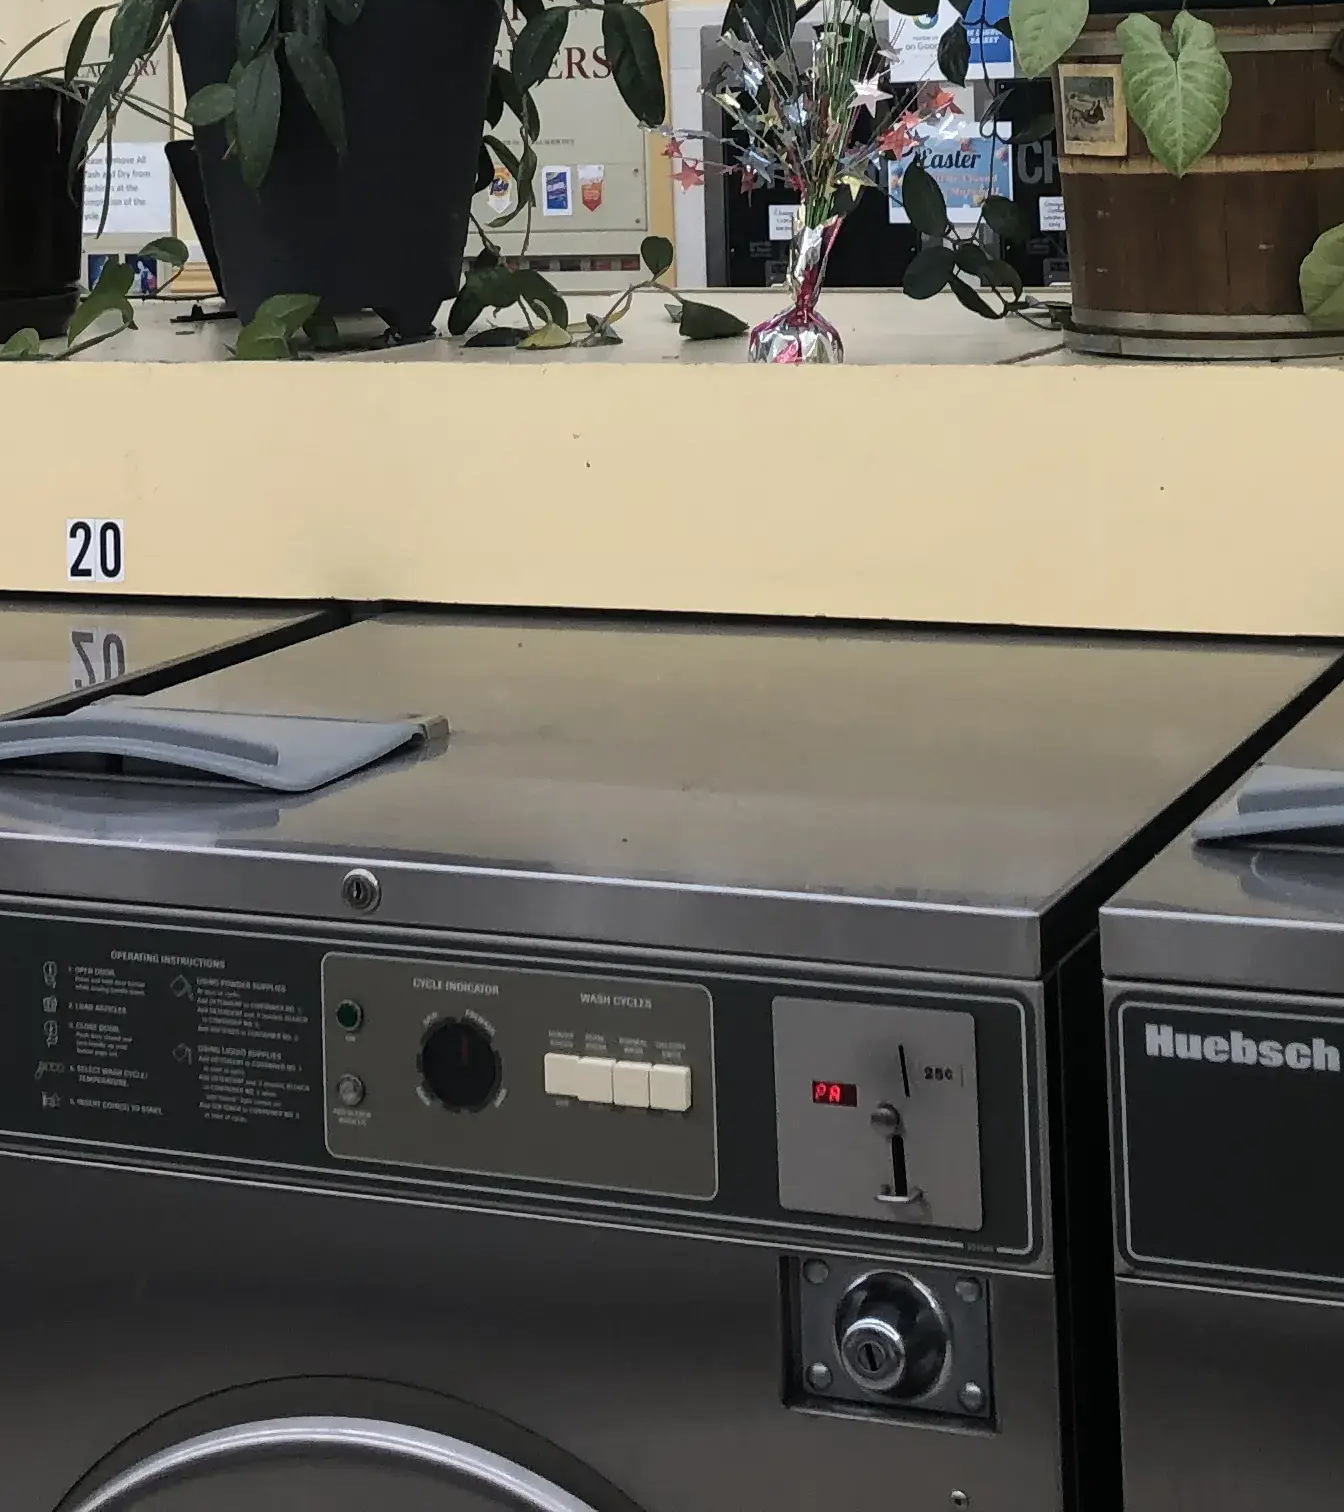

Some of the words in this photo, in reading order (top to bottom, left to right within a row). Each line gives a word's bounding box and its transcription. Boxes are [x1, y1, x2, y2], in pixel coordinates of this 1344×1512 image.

[69, 521, 123, 579] 20
[110, 949, 159, 964] OPERATING
[160, 954, 226, 969] INSTRUCTIONS
[412, 976, 442, 990] CYCLE
[445, 980, 500, 996] INDICATOR
[580, 992, 611, 1005] WASH
[612, 995, 652, 1009] CYCLES
[1145, 1022, 1341, 1073] Huebsch
[923, 1065, 954, 1081] 25¢
